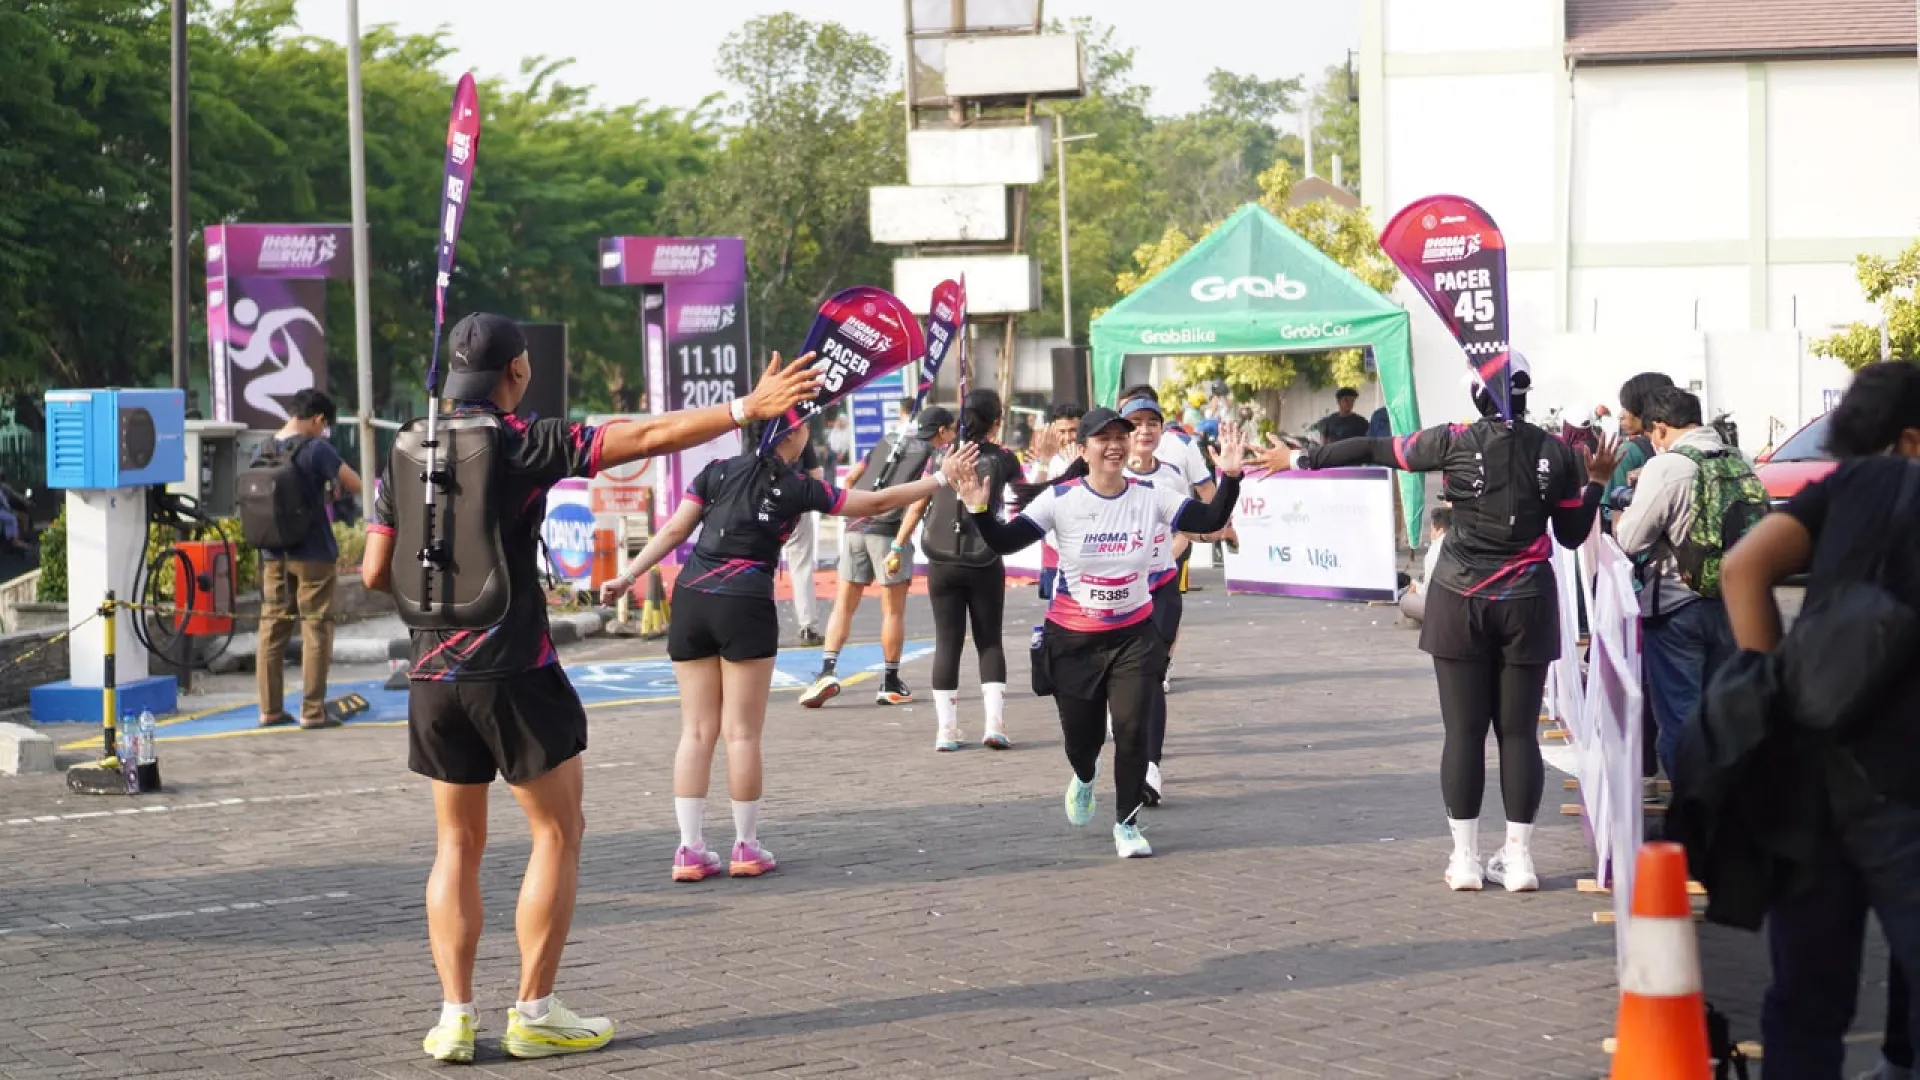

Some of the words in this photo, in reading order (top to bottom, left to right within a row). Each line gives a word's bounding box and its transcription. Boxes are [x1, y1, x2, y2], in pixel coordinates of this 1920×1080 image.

[1441, 246, 1465, 257] RUN
[1191, 273, 1306, 301] Grab
[1434, 269, 1491, 291] PACER
[1454, 290, 1495, 322] 45
[678, 345, 737, 375] 11.10
[822, 338, 871, 376] PACER
[682, 379, 736, 409] 2026
[550, 519, 595, 553] DANON
[1083, 532, 1128, 544] IHGMA
[1097, 543, 1127, 553] RUN
[1090, 588, 1130, 601] F5385
